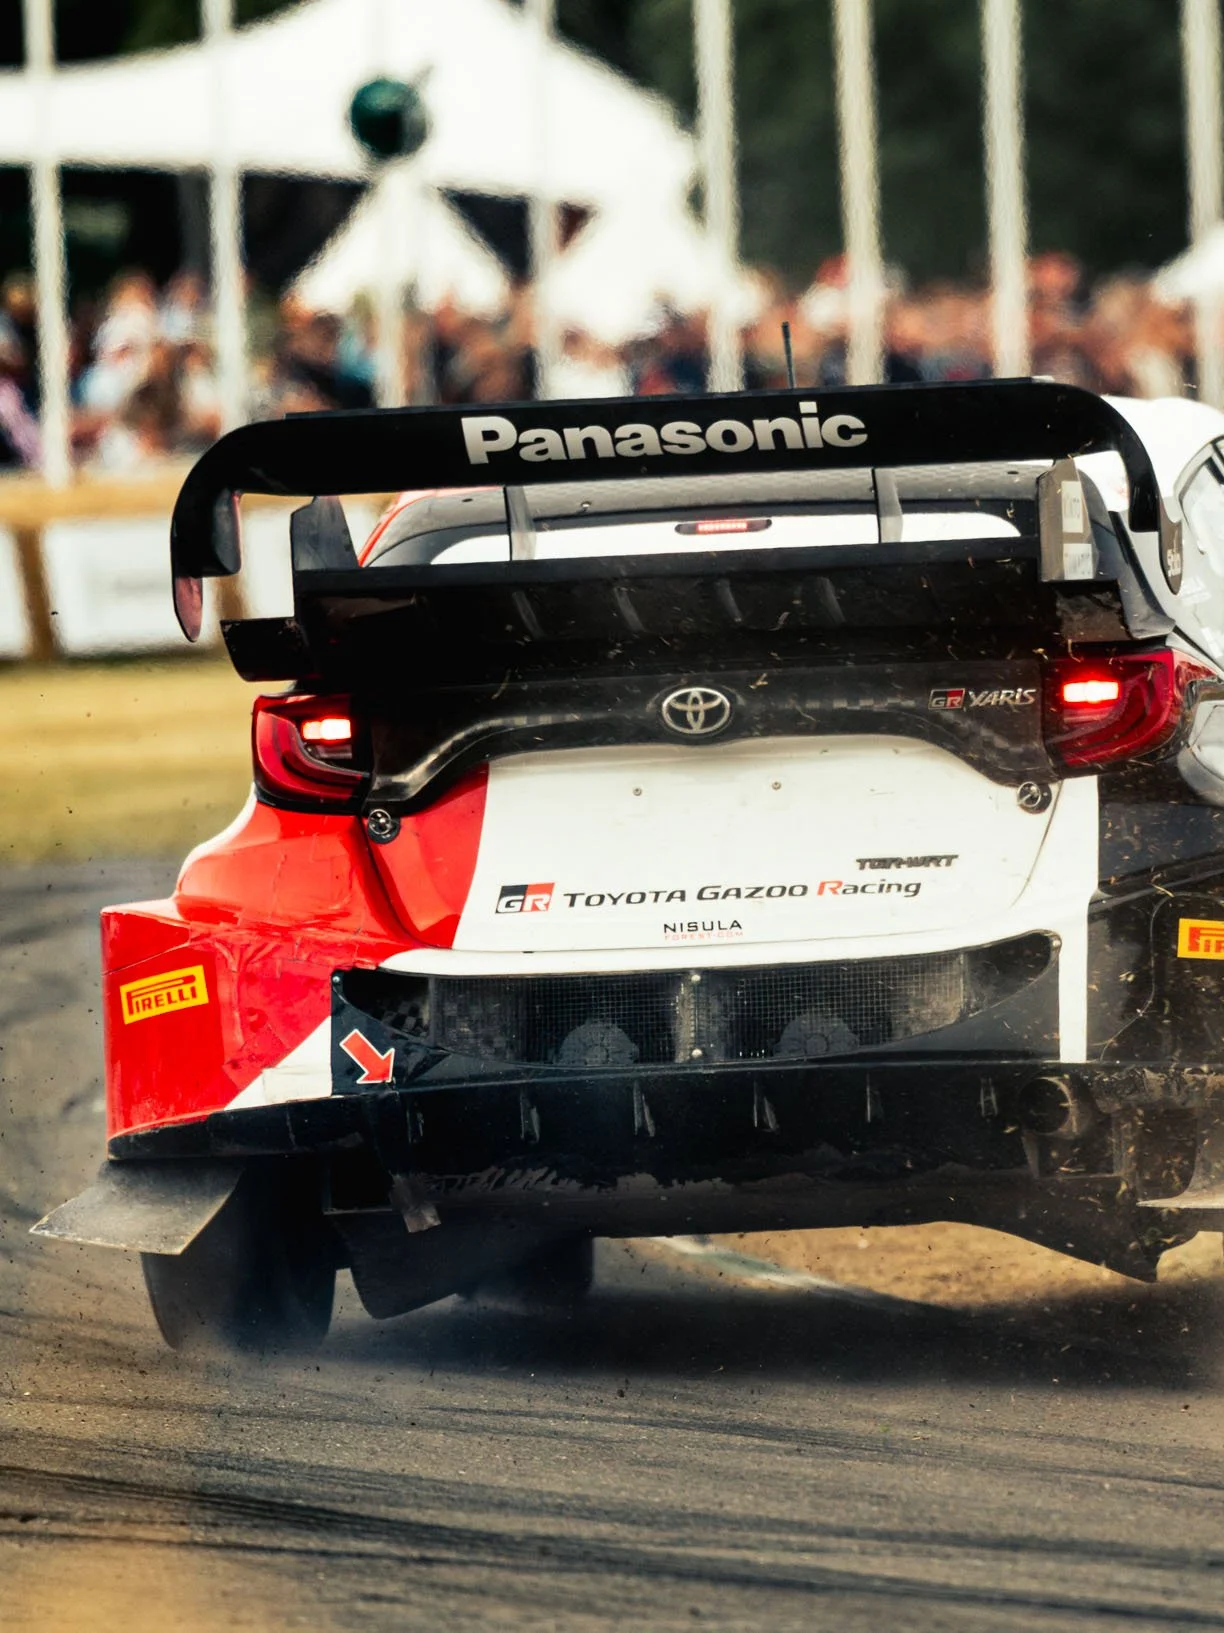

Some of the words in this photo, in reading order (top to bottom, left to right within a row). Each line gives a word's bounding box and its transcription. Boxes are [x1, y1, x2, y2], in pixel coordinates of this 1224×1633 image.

[461, 401, 868, 465] Panasonic
[496, 891, 551, 913] GR
[563, 889, 686, 908] TOYOTA
[697, 884, 809, 901] GAZOO
[817, 878, 922, 898] Racing
[664, 919, 742, 933] NISULA
[125, 974, 197, 1016] PIRELLI
